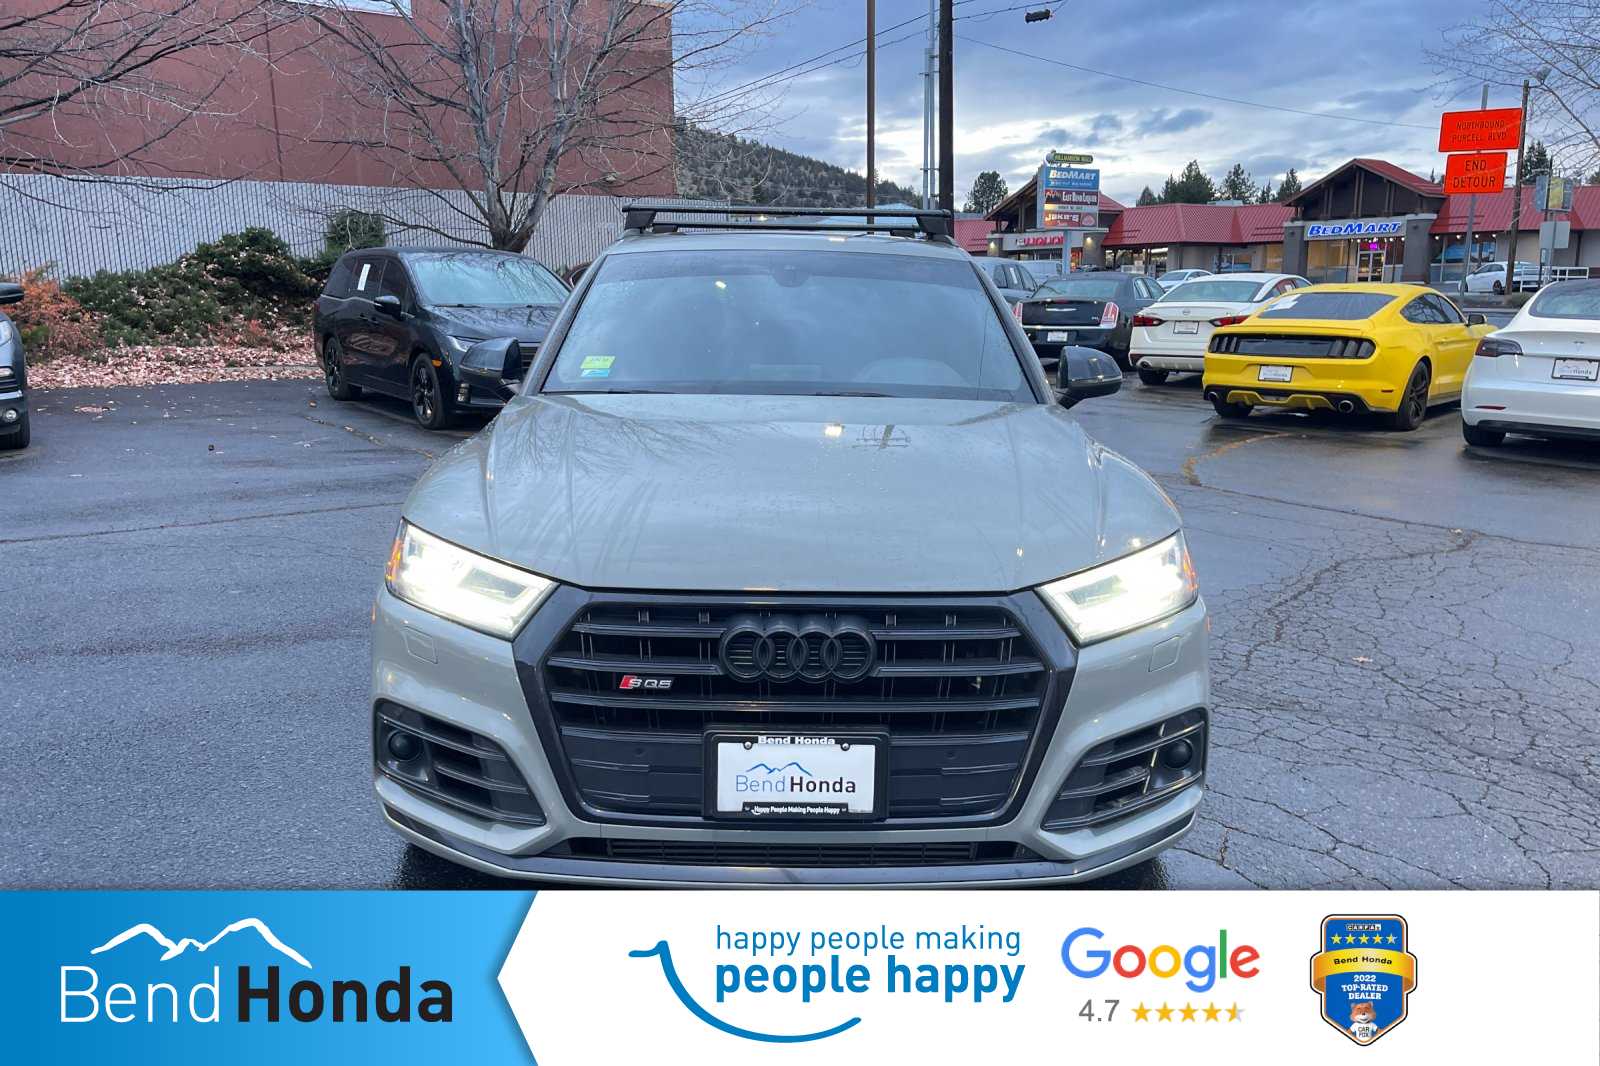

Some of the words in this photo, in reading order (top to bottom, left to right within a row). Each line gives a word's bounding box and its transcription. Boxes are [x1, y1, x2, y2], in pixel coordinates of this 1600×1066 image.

[1465, 160, 1487, 171] END
[1453, 176, 1496, 188] DETOUR
[623, 676, 672, 688] SQ5
[758, 736, 791, 745] Bend
[795, 736, 835, 745] Honda
[735, 775, 785, 792] Bend
[790, 776, 856, 793] Honda
[754, 805, 770, 814] Happy
[824, 806, 840, 815] Happy
